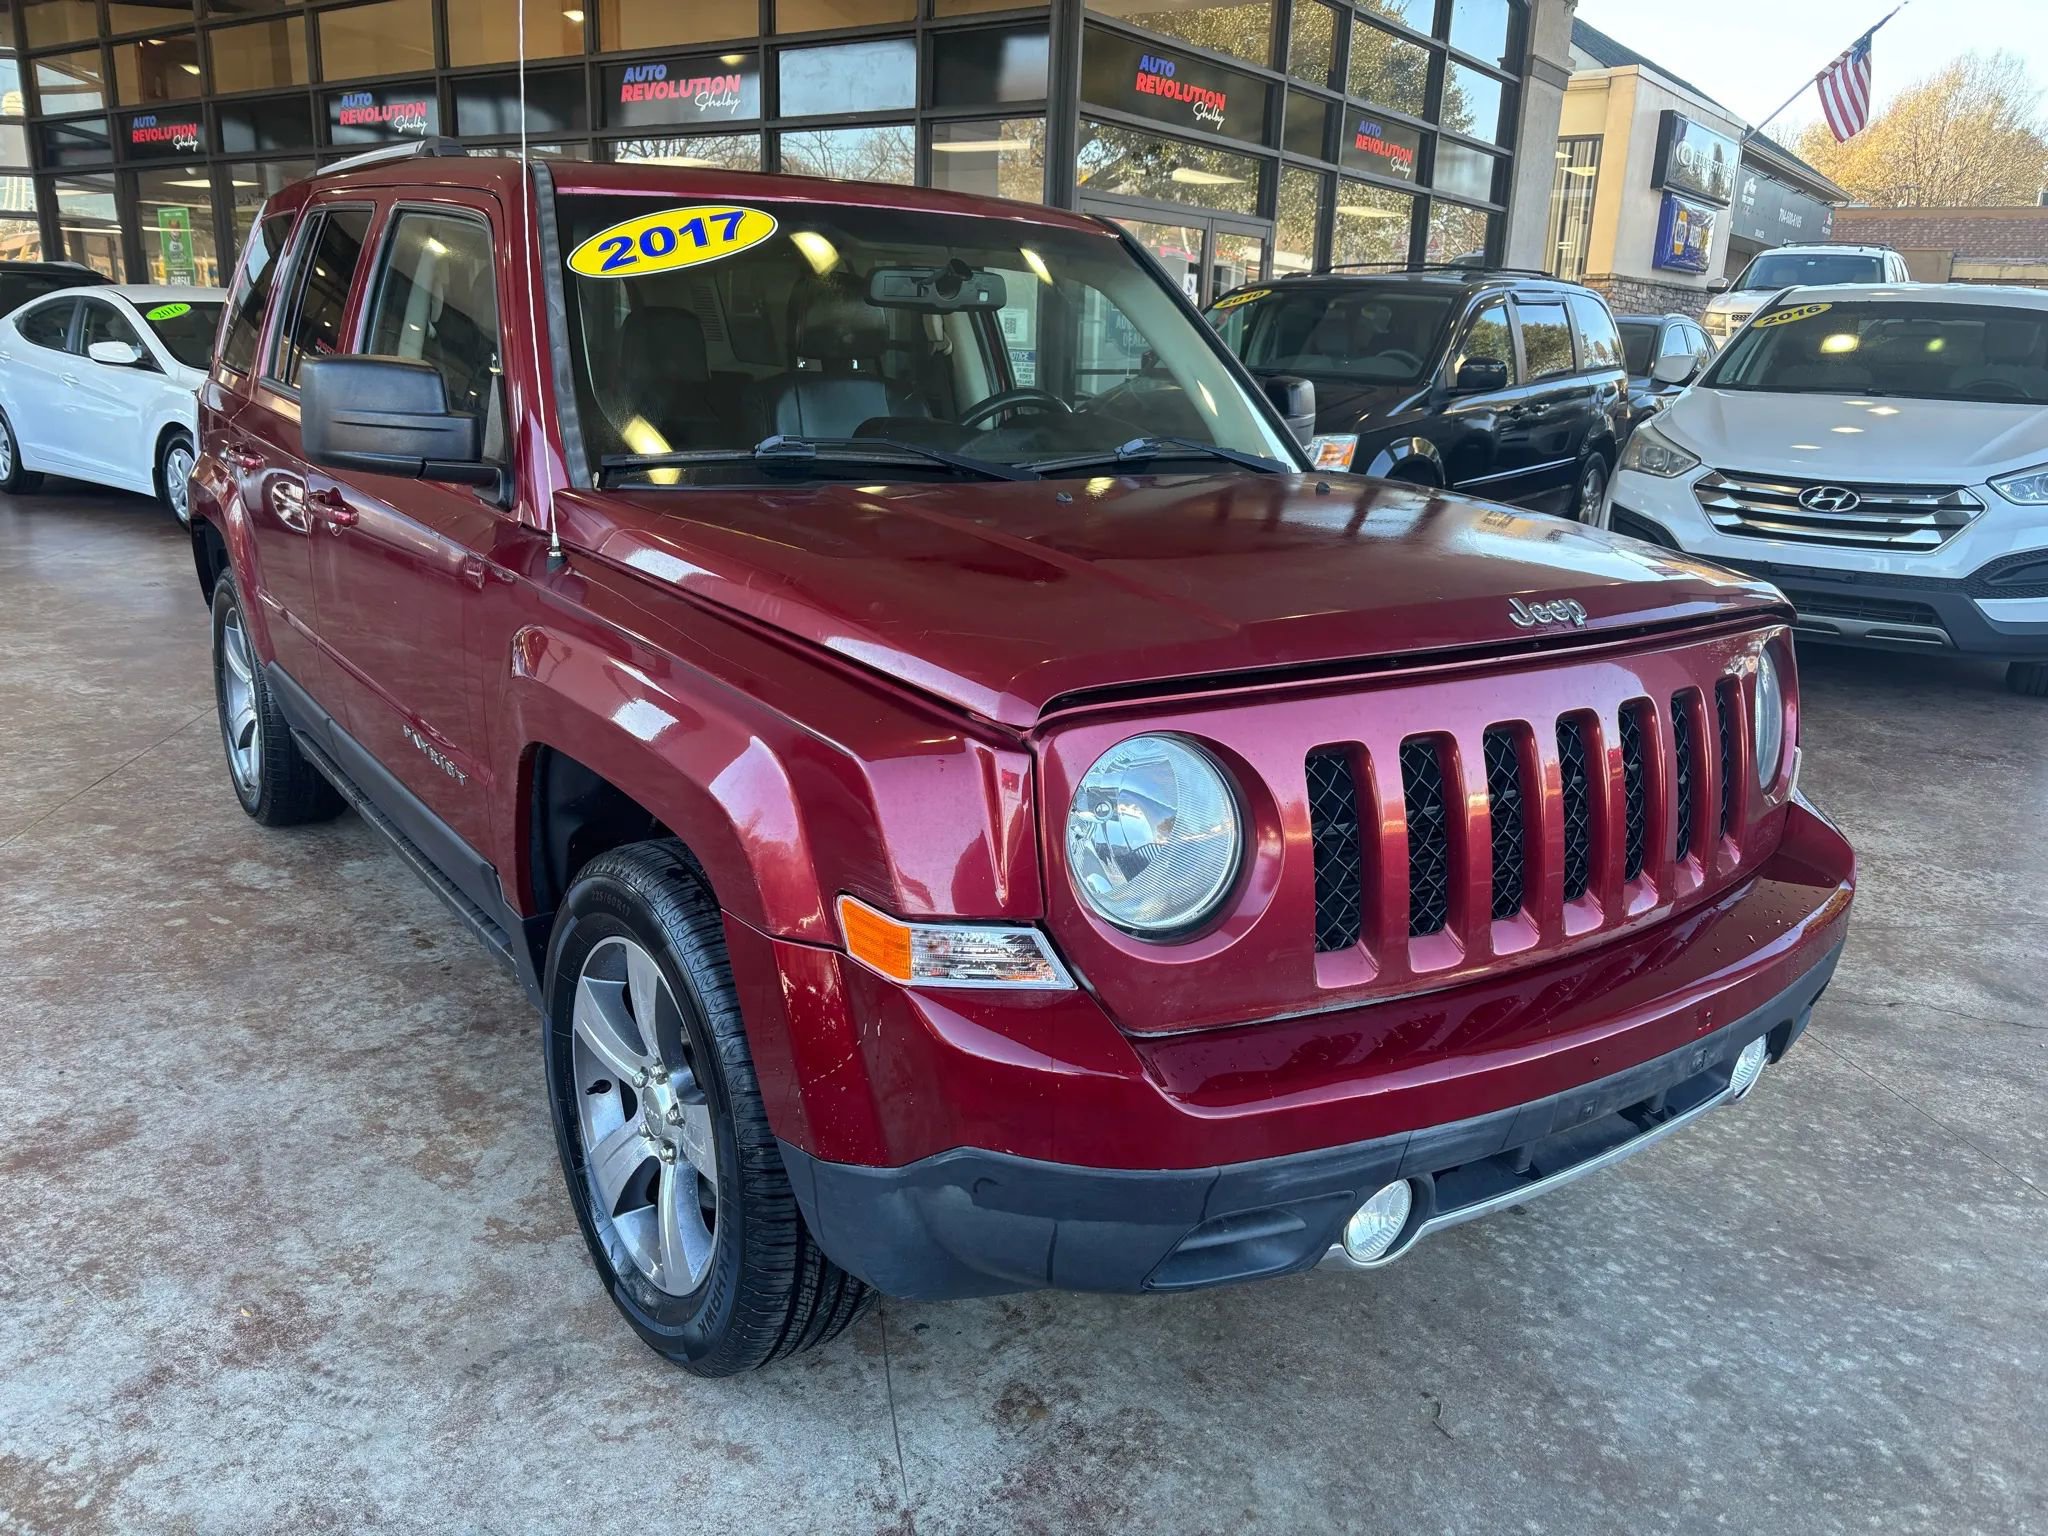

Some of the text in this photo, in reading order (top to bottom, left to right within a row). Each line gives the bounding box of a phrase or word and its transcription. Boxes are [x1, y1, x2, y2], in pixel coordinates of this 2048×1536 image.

[623, 64, 668, 84] AUTO
[1139, 54, 1176, 78] AUTO
[341, 92, 373, 108] AUTO
[620, 74, 741, 102] REVOLUTION
[1135, 72, 1227, 111] REVOLUTION
[340, 101, 427, 125] REVOLUTION
[694, 87, 741, 115] Shelby
[132, 115, 157, 129] AUTO
[393, 112, 429, 135] Shelby
[1192, 101, 1225, 131] Shelby
[132, 123, 198, 144] REVOLUTION
[1358, 120, 1382, 138] AUTO
[172, 132, 199, 153] Shelby
[1355, 133, 1414, 164] REVOLUTION
[597, 210, 747, 273] 2017
[155, 305, 184, 319] 2016
[1762, 304, 1822, 326] 2016
[1508, 597, 1588, 629] Jeep
[402, 724, 468, 786] PATRIOT
